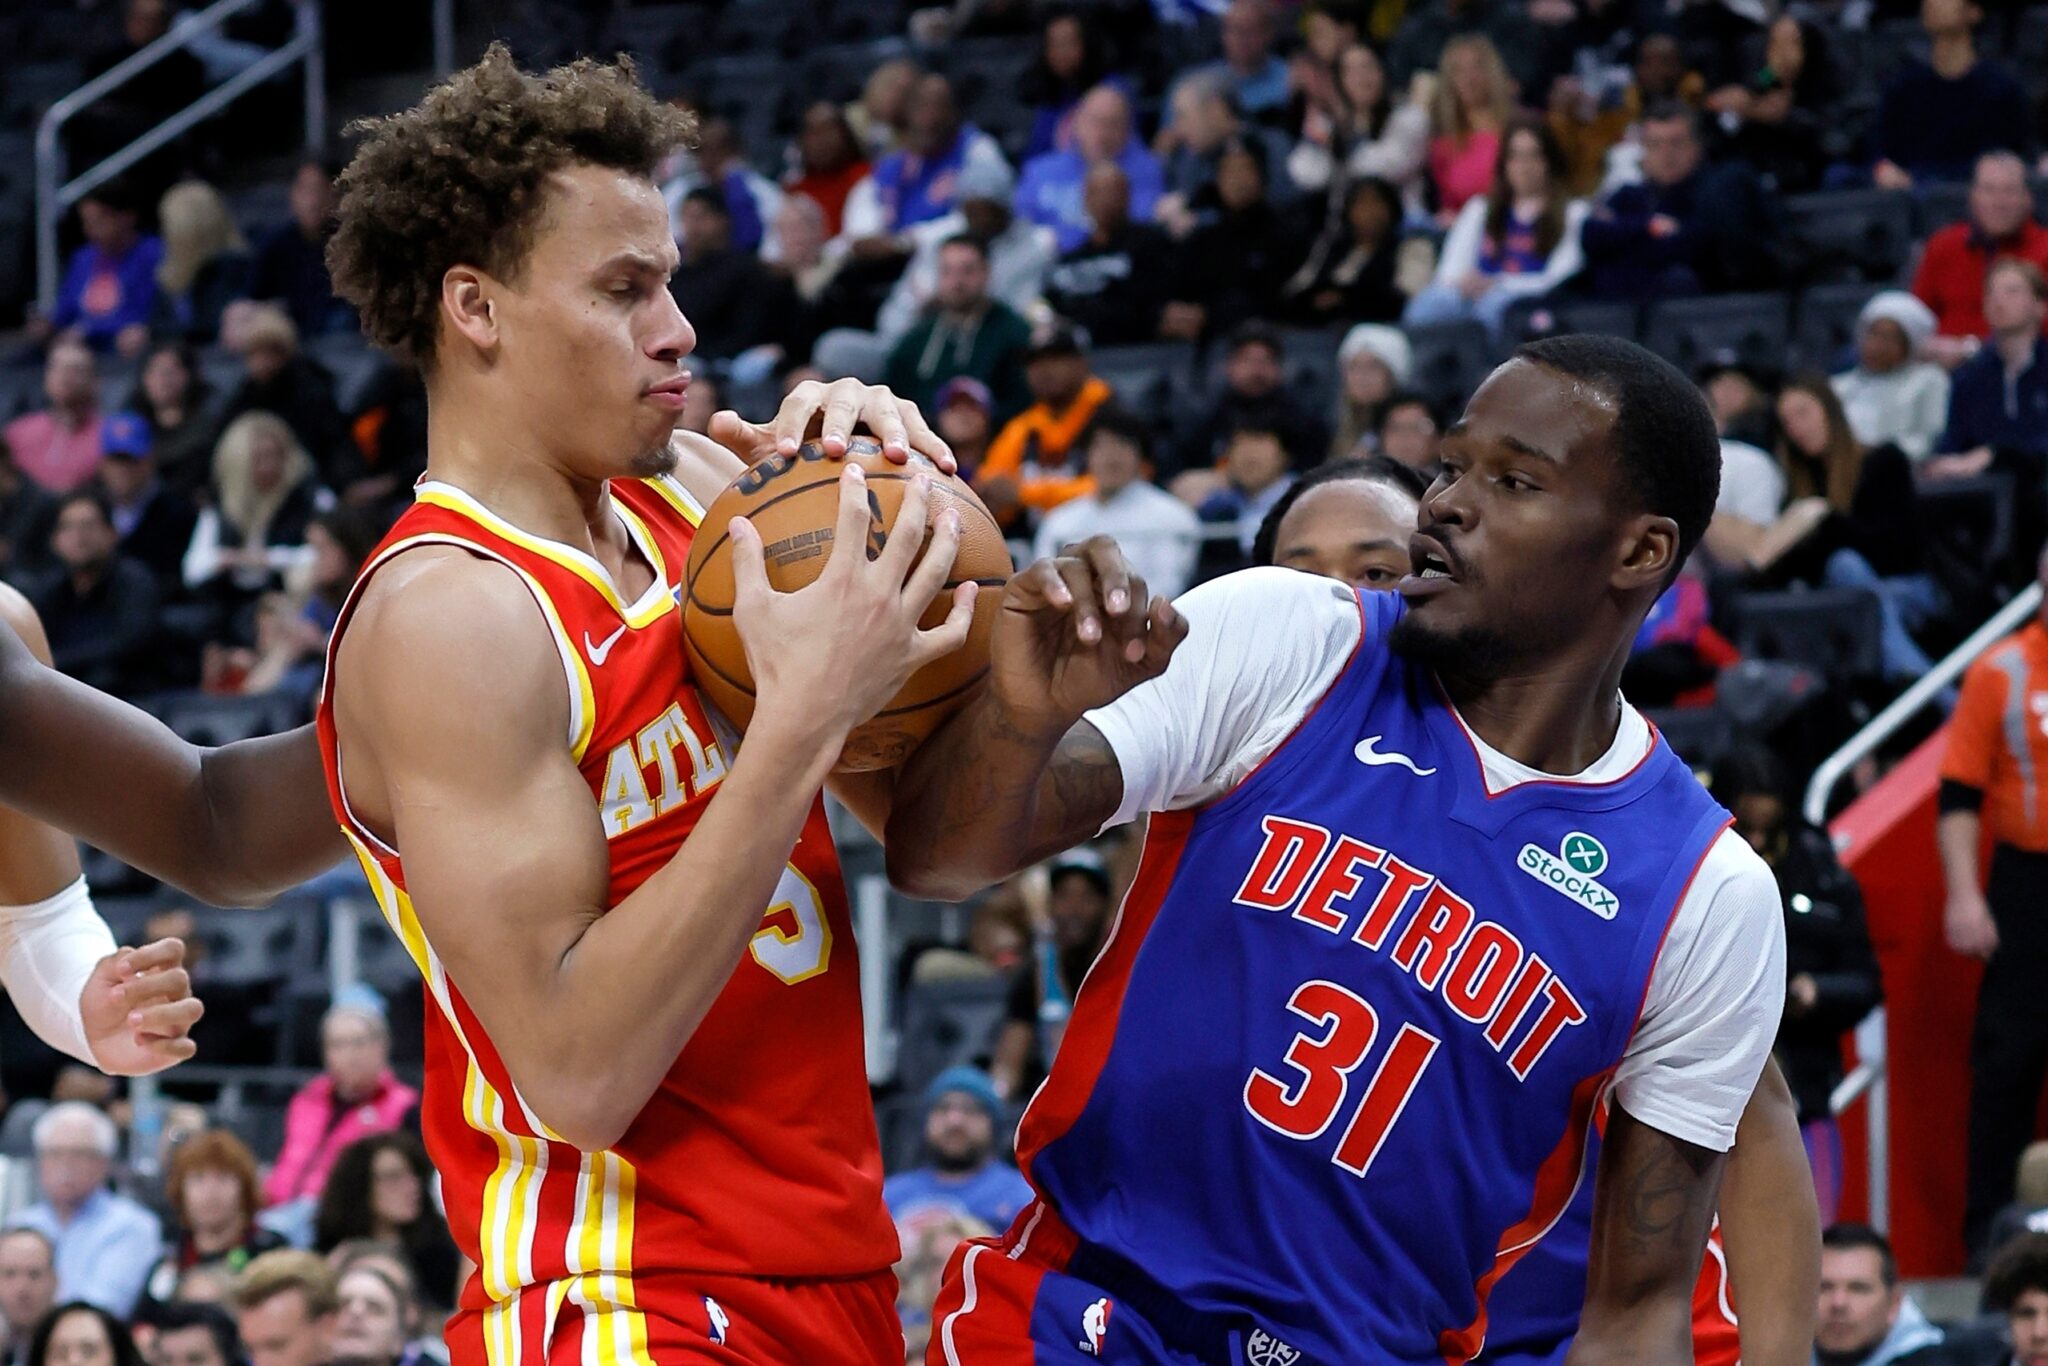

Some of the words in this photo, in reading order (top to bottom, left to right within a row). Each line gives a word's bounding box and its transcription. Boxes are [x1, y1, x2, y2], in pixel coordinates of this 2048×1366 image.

[1232, 815, 1588, 1082] DETROIT
[1522, 848, 1616, 916] StockX
[1243, 979, 1441, 1179] 31
